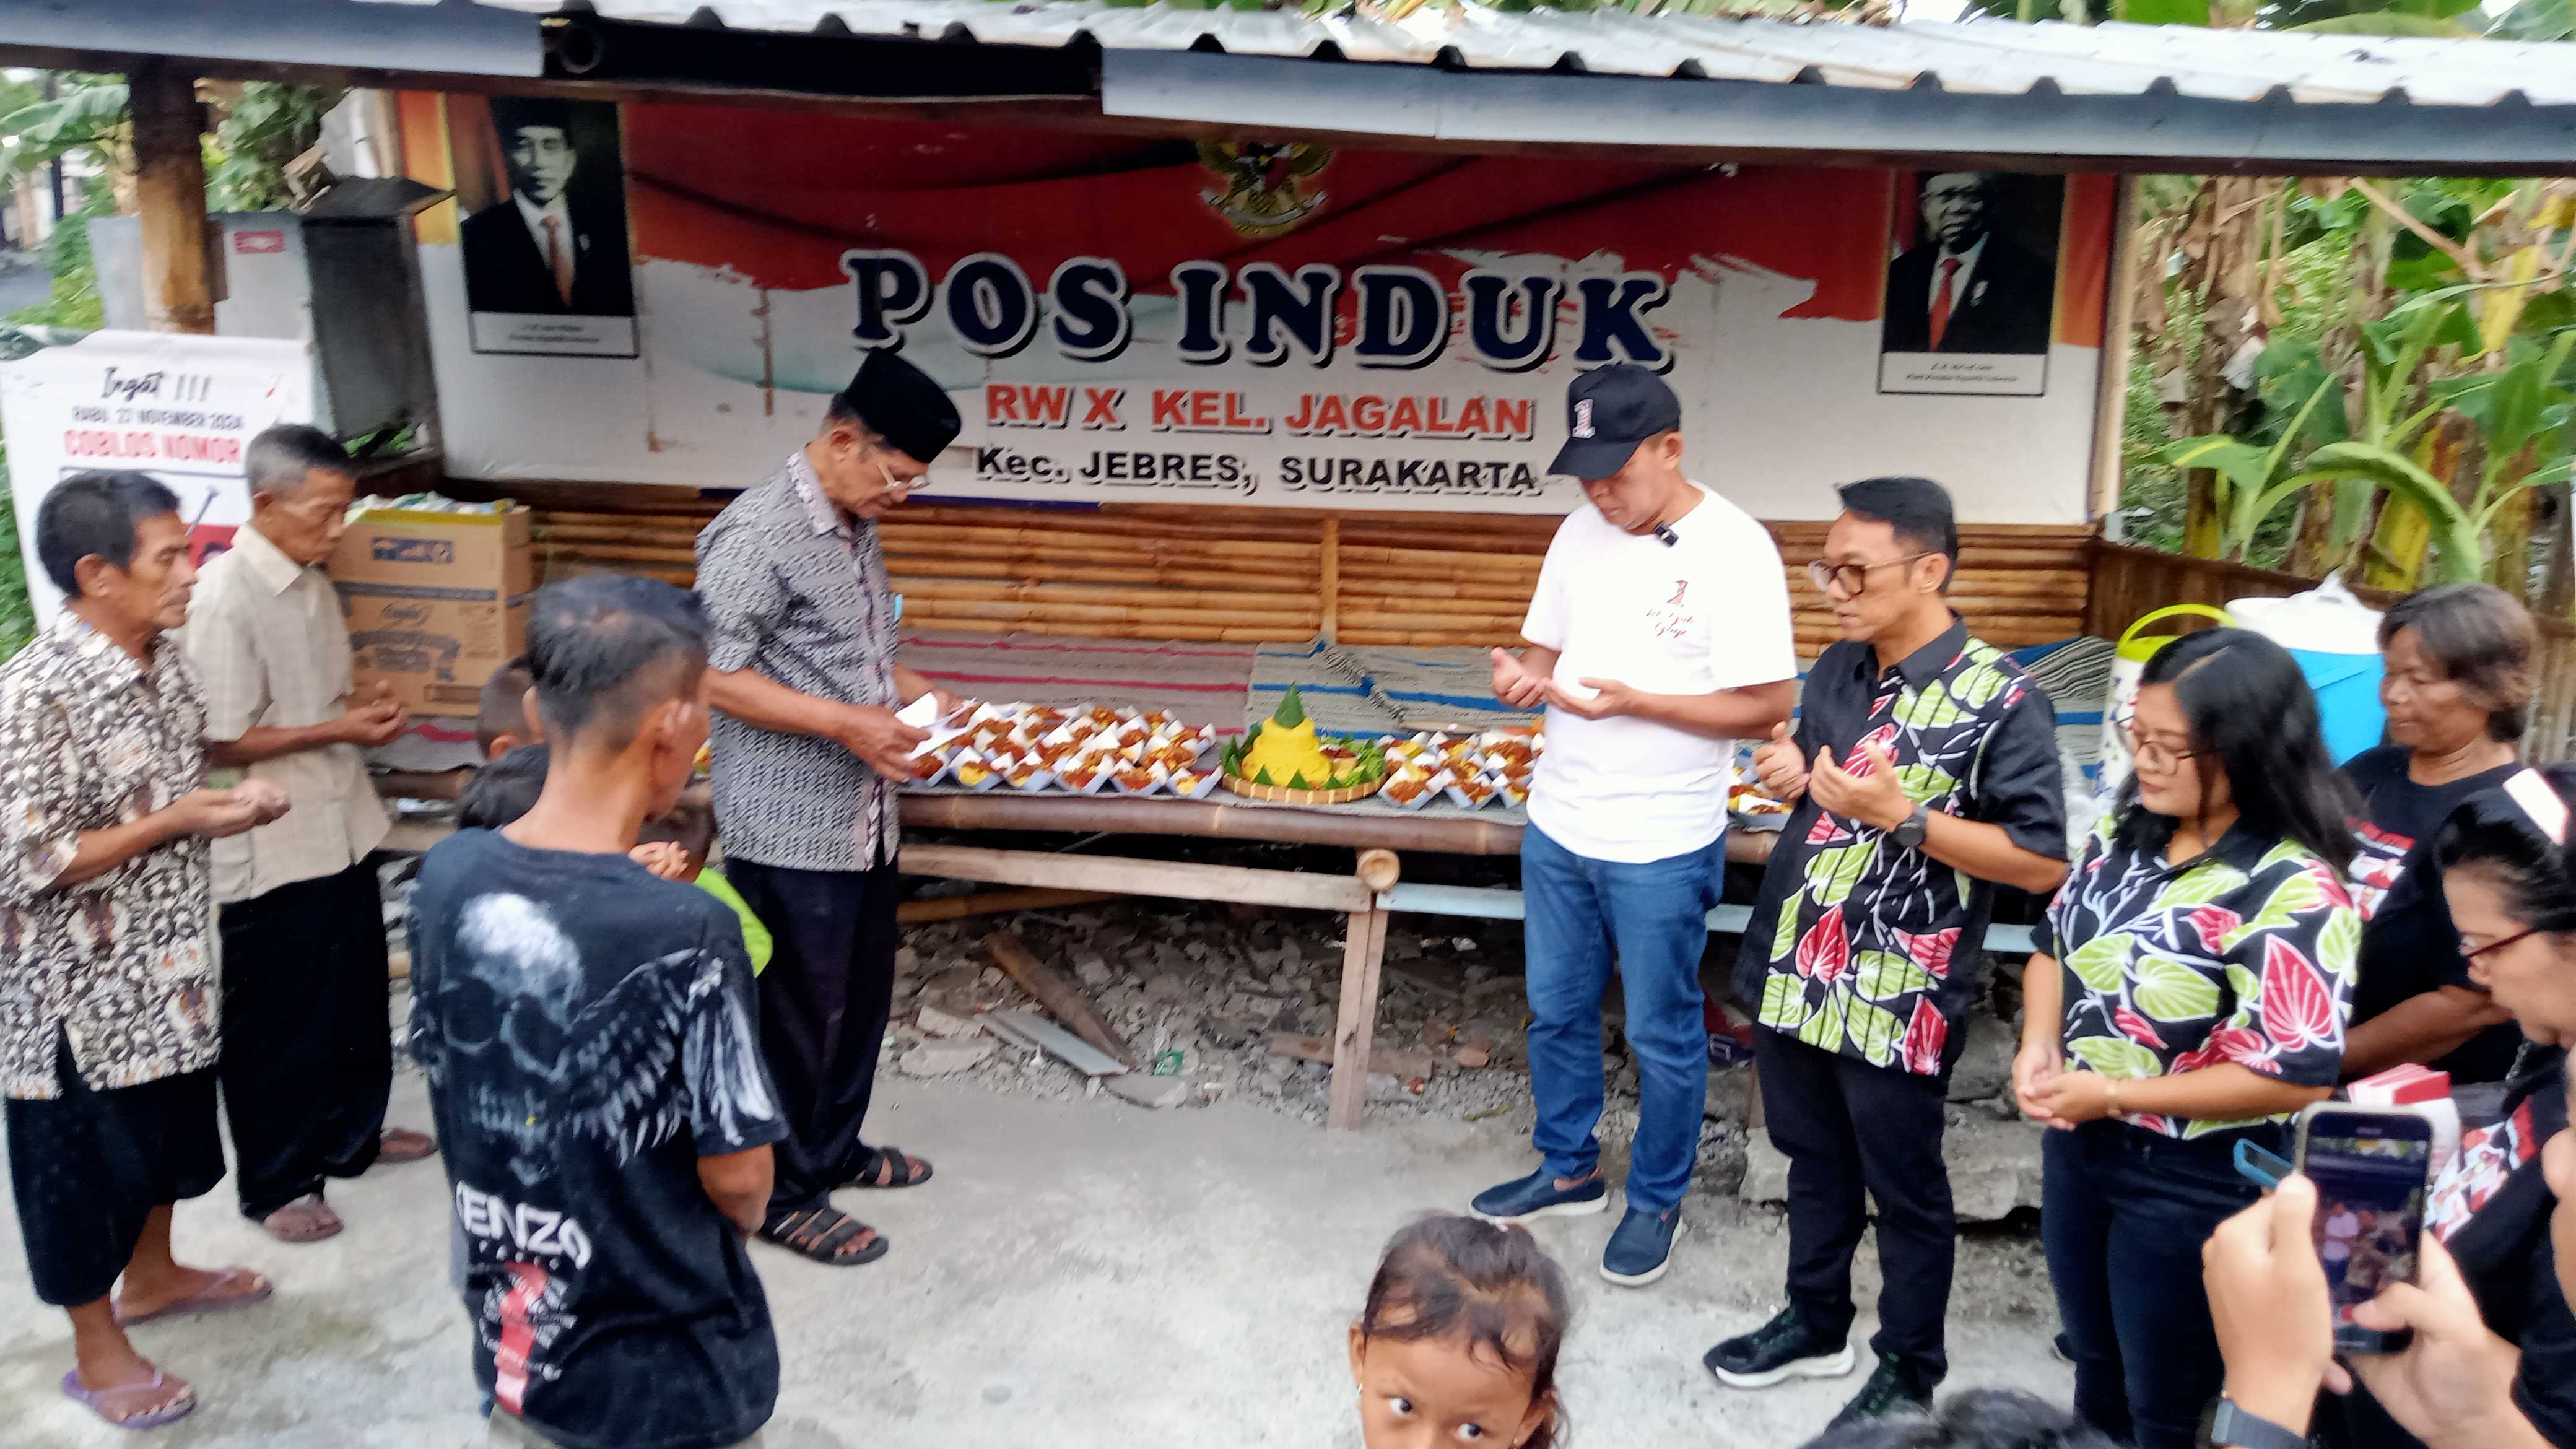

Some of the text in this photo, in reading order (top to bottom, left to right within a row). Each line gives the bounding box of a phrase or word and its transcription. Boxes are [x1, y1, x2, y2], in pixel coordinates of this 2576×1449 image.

[839, 248, 1674, 375] POS INDUK
[101, 365, 165, 402] Ingat
[139, 409, 207, 426] NOVEMBER
[986, 383, 1536, 442] RW X KEL. JAGALAN
[1572, 398, 1596, 438] 1
[64, 430, 241, 463] COBLOS NOMOR
[1079, 451, 1258, 495] JEBRES,
[1279, 455, 1542, 495] SURAKARTA
